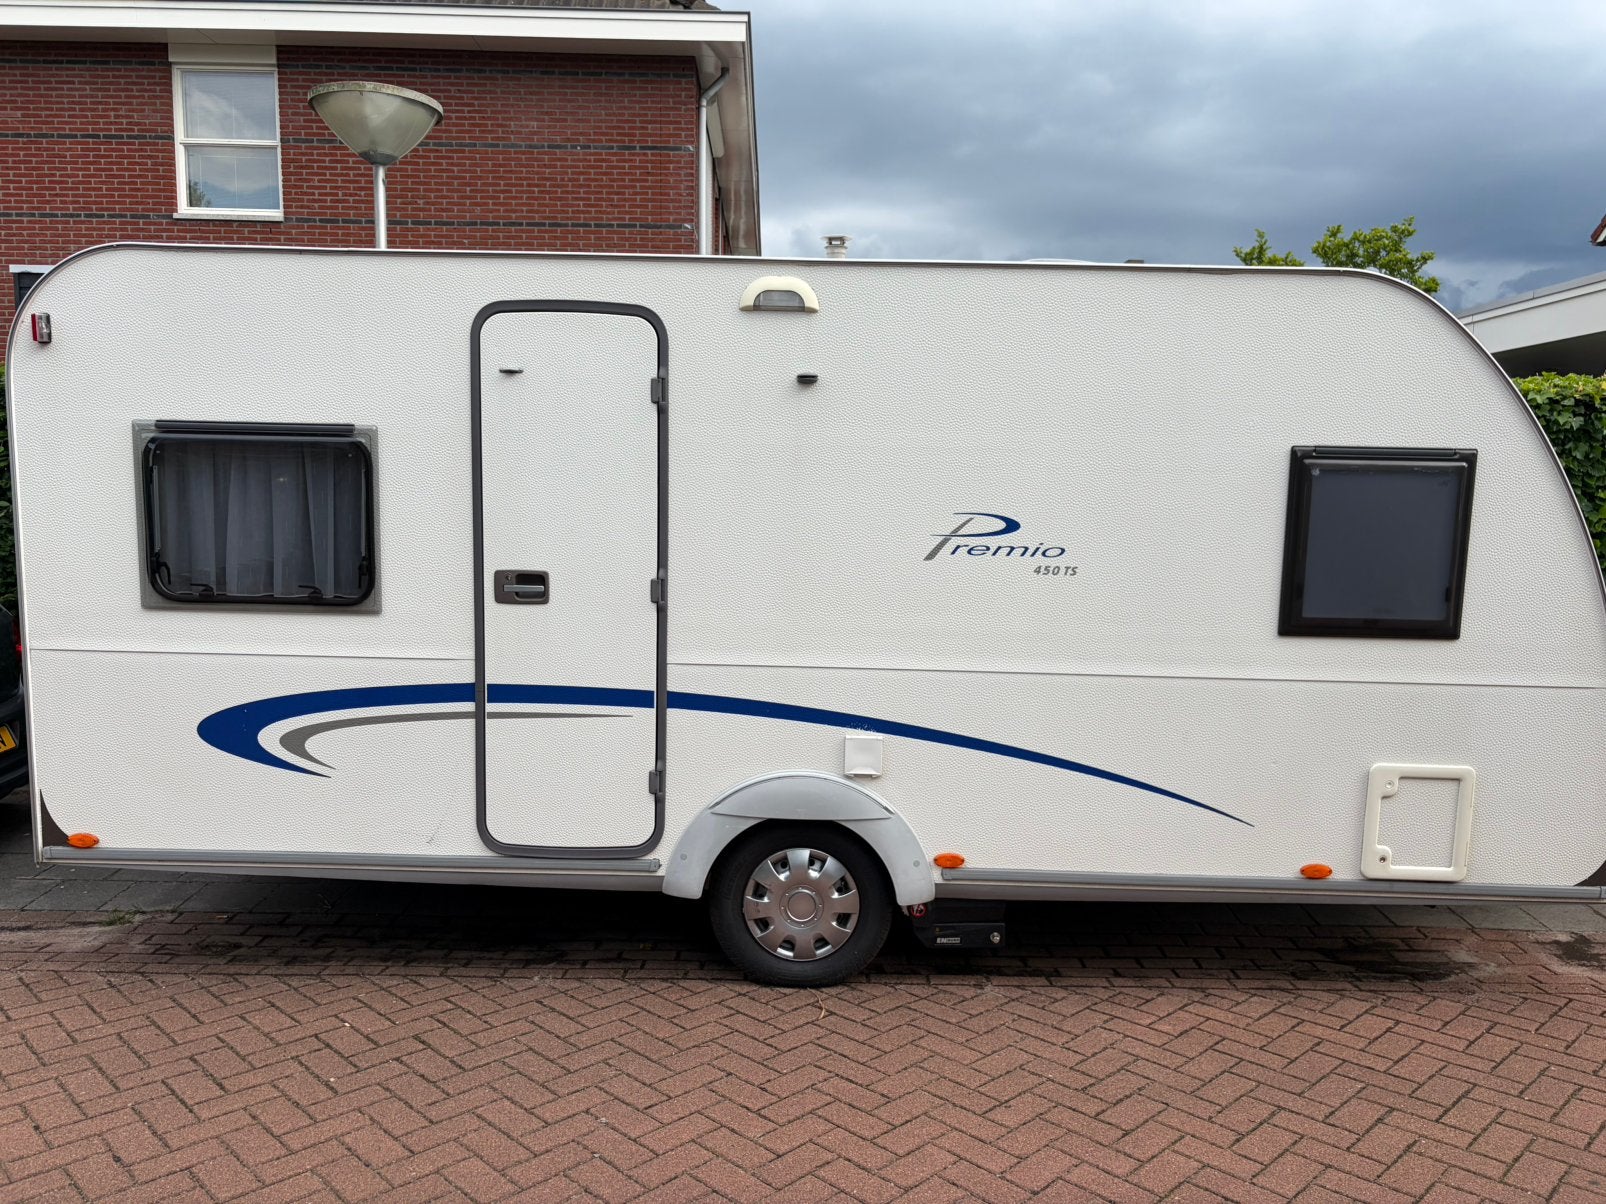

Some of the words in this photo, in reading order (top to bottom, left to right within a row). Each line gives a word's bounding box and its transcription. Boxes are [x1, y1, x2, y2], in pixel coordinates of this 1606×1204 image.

[923, 512, 1066, 561] Premio
[1033, 565, 1061, 576] 450
[1063, 566, 1079, 576] TS
